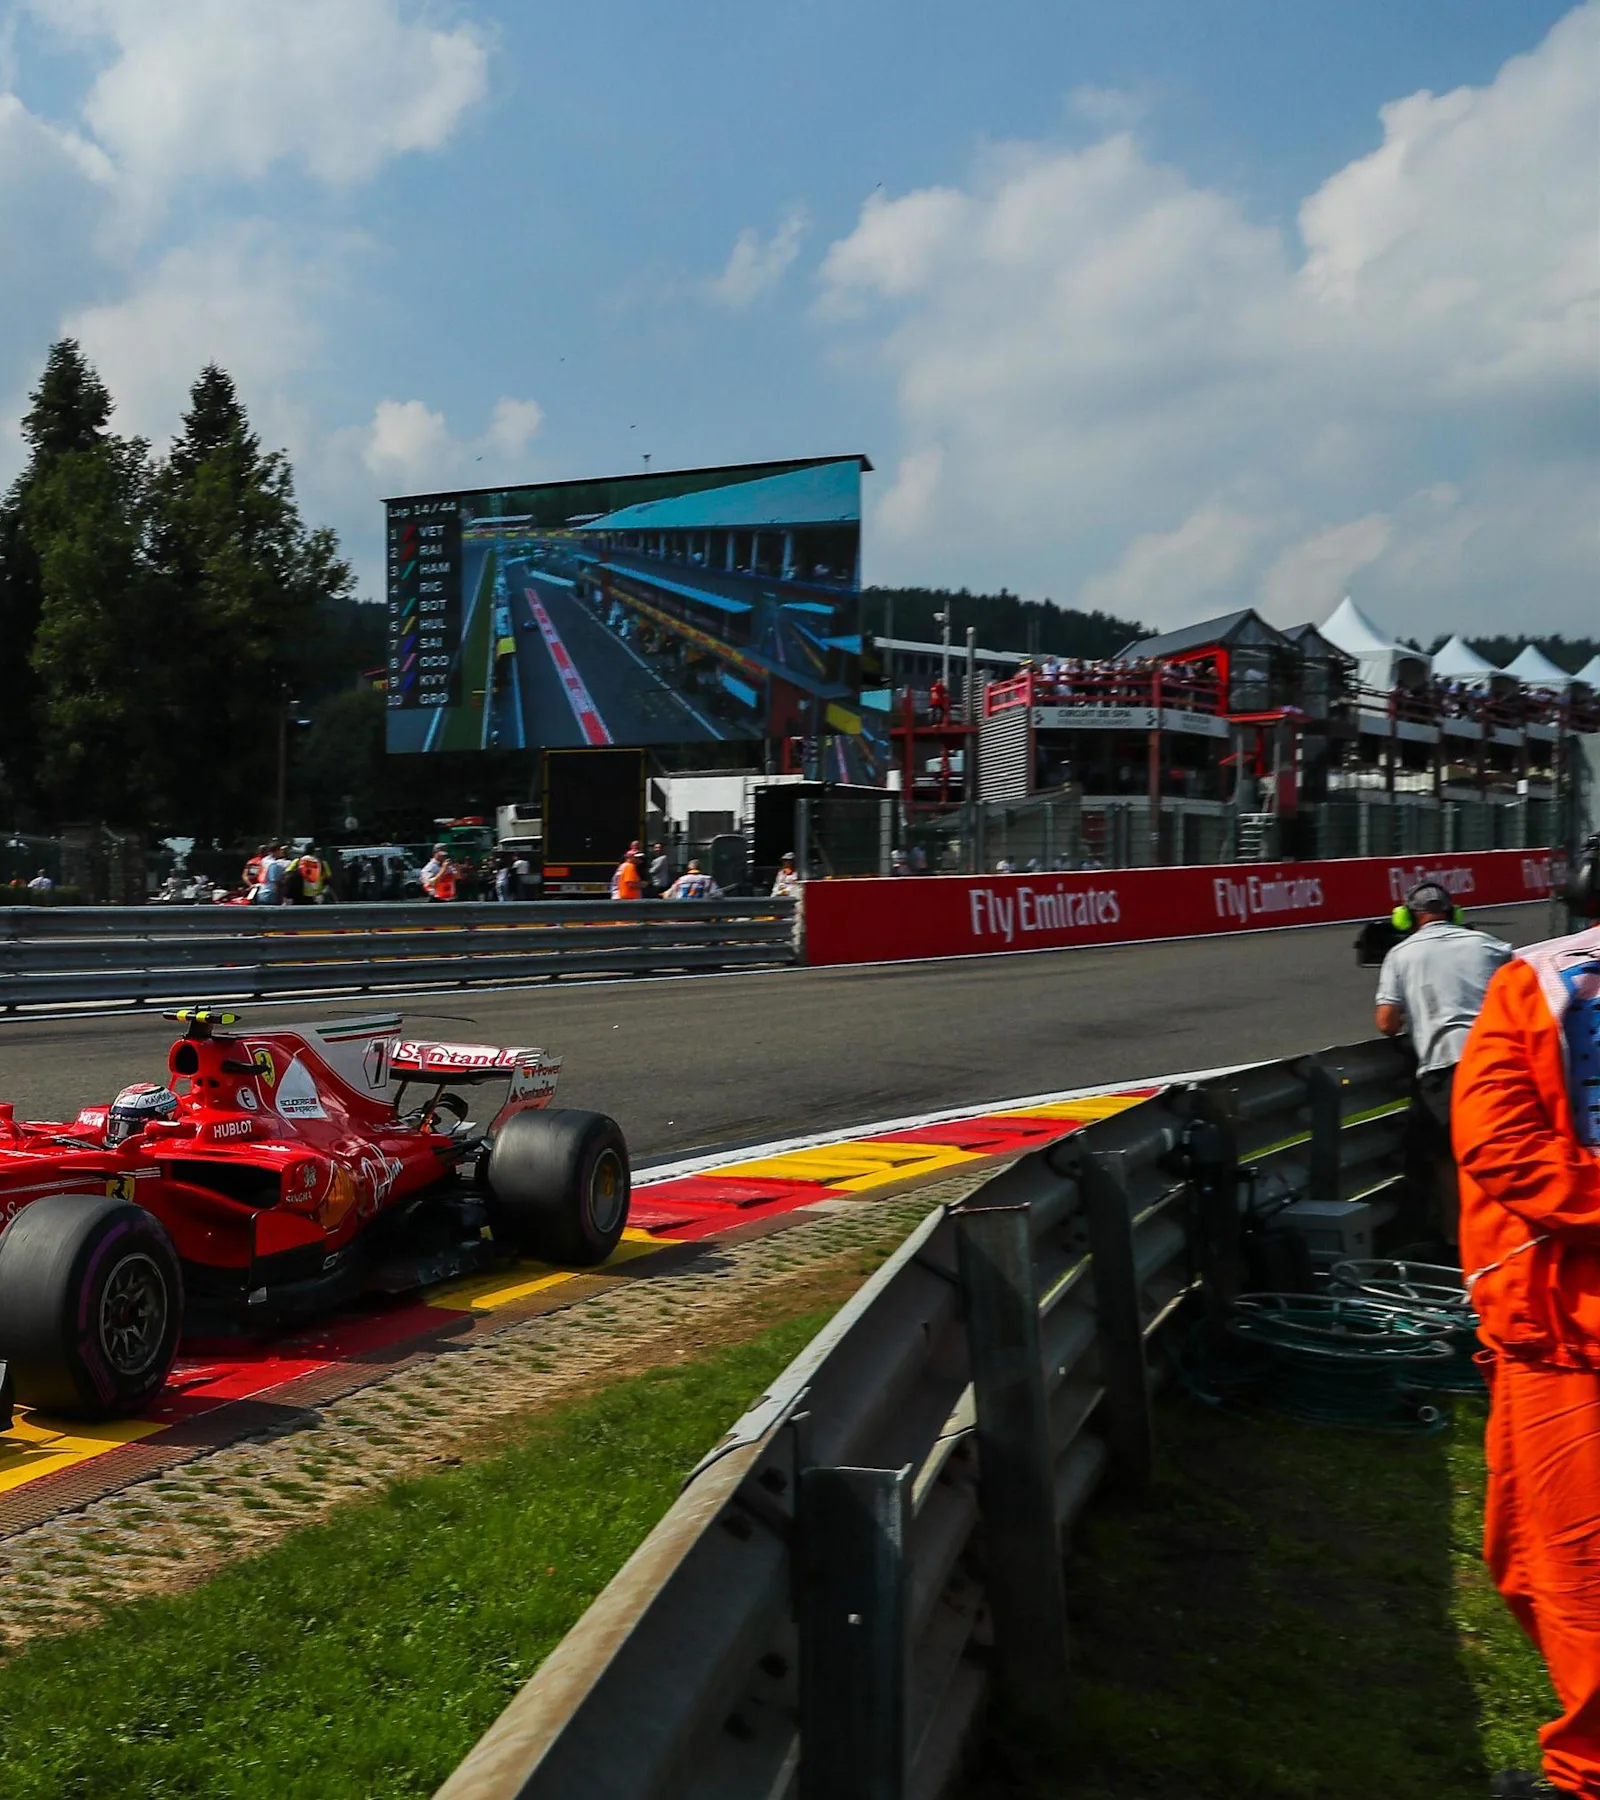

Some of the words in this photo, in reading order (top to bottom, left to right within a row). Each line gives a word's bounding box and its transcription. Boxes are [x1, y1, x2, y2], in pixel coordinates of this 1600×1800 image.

[389, 508, 410, 518] Lap
[414, 502, 456, 515] 14/44
[390, 529, 397, 540] 1
[419, 525, 445, 536] VET
[390, 547, 399, 558] 2
[420, 544, 442, 555] RAI
[390, 566, 399, 576] 3
[420, 562, 450, 573] HAM
[389, 584, 398, 593] 4
[420, 581, 443, 592] RIC
[390, 602, 399, 613] 5
[420, 600, 447, 611] BOT
[390, 621, 399, 631] 6
[420, 619, 447, 629] HUL
[390, 640, 398, 650] 7
[420, 637, 442, 648] SAI
[390, 658, 399, 668] 8
[420, 656, 449, 667] OCO
[390, 676, 399, 687] 9
[420, 674, 447, 686] KVY
[388, 695, 403, 706] 10
[420, 692, 449, 704] GRO
[1214, 877, 1247, 922] Fly
[1247, 872, 1324, 914] Emirates
[969, 888, 1014, 943] Fly
[1016, 882, 1120, 932] Emirates
[519, 1080, 555, 1100] Santander
[213, 1120, 253, 1138] HUBLOT
[285, 1191, 313, 1203] SINGHA
